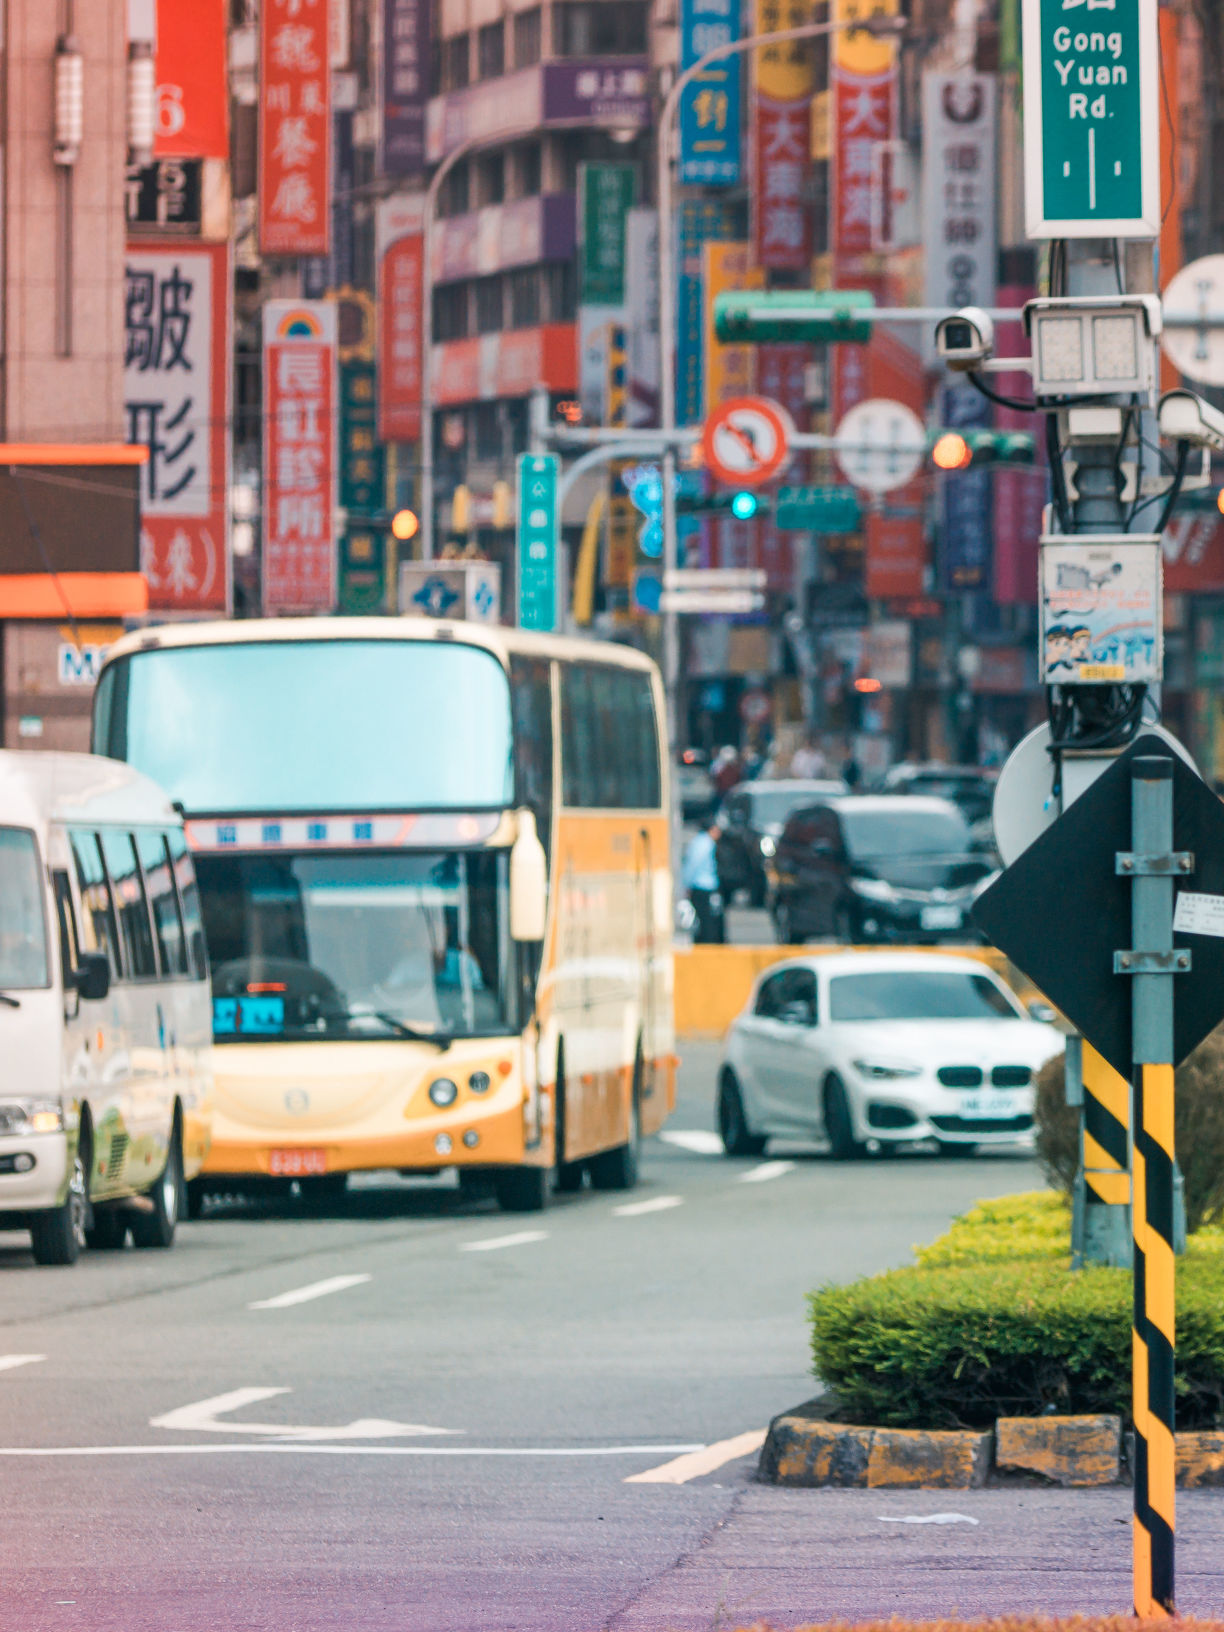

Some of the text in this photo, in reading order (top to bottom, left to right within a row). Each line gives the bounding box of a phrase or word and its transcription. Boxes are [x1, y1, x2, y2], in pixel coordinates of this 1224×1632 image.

[1053, 26, 1122, 59] Gong
[1053, 59, 1127, 86] Yuan
[1069, 92, 1114, 119] Rd.
